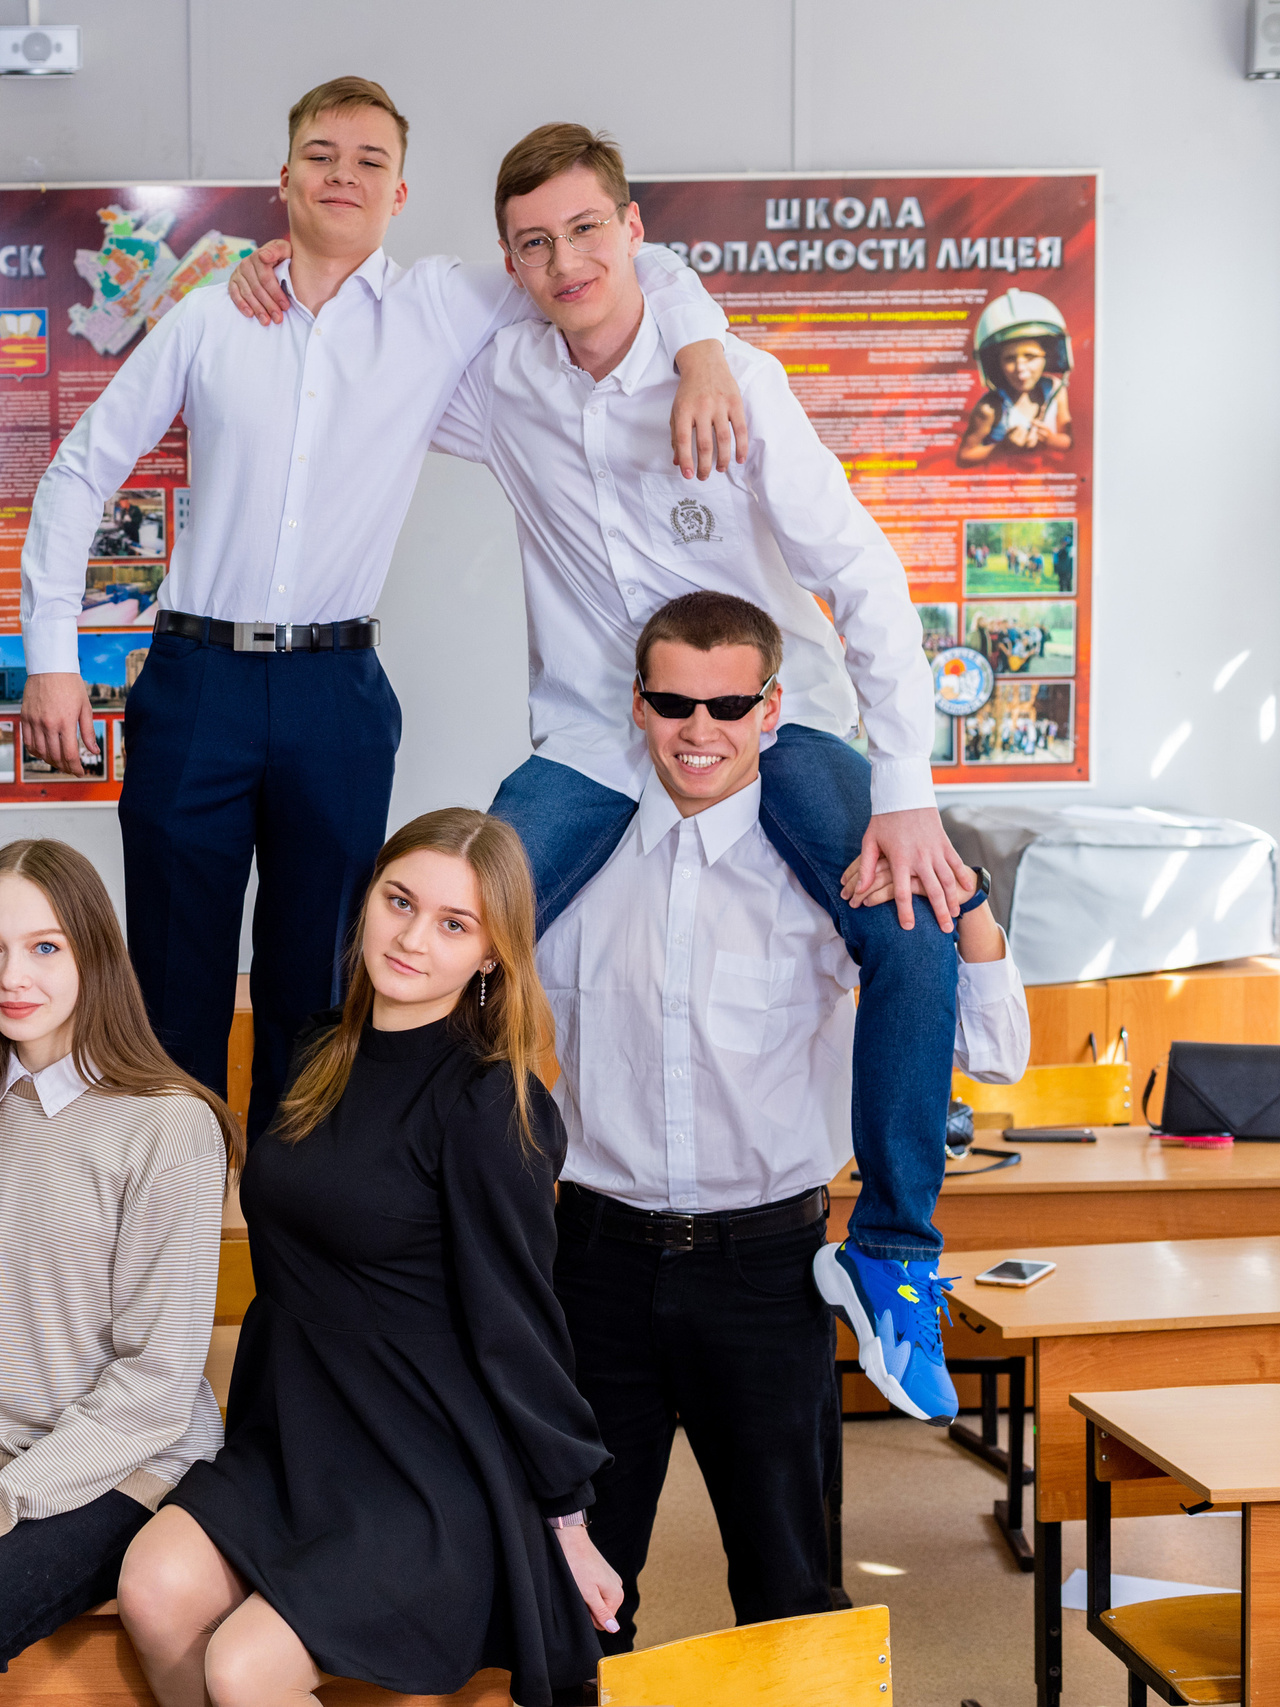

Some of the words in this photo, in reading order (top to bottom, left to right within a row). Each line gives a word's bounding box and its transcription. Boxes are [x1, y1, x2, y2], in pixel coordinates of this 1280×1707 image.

[765, 196, 925, 230] ШКОЛА
[655, 237, 926, 273] ЗОПАСНОСТИ
[935, 235, 1063, 272] ЛИЦЕЯ
